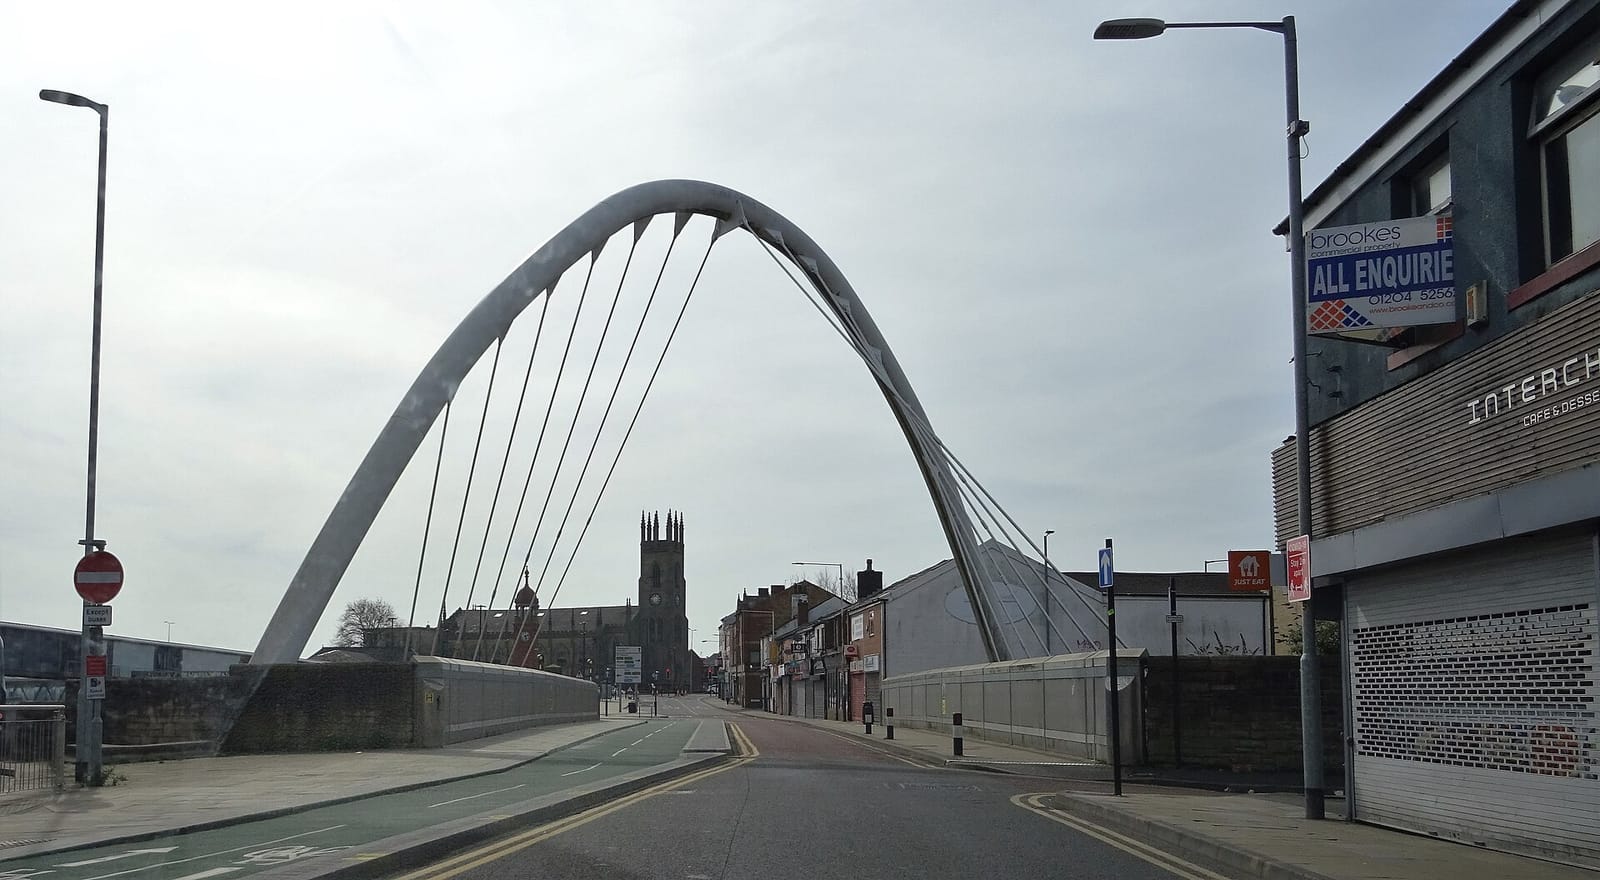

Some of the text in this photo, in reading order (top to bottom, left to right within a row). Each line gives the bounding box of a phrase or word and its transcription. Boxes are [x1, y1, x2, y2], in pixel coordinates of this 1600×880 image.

[1311, 226, 1400, 249] brookes
[1311, 241, 1401, 258] commercial property
[1313, 249, 1454, 296] ALL ENQUIRIE
[1369, 288, 1455, 305] 01204 5256
[1523, 390, 1600, 427] CAFE & DESSE
[1233, 578, 1251, 586] JUST
[86, 608, 109, 617] Except
